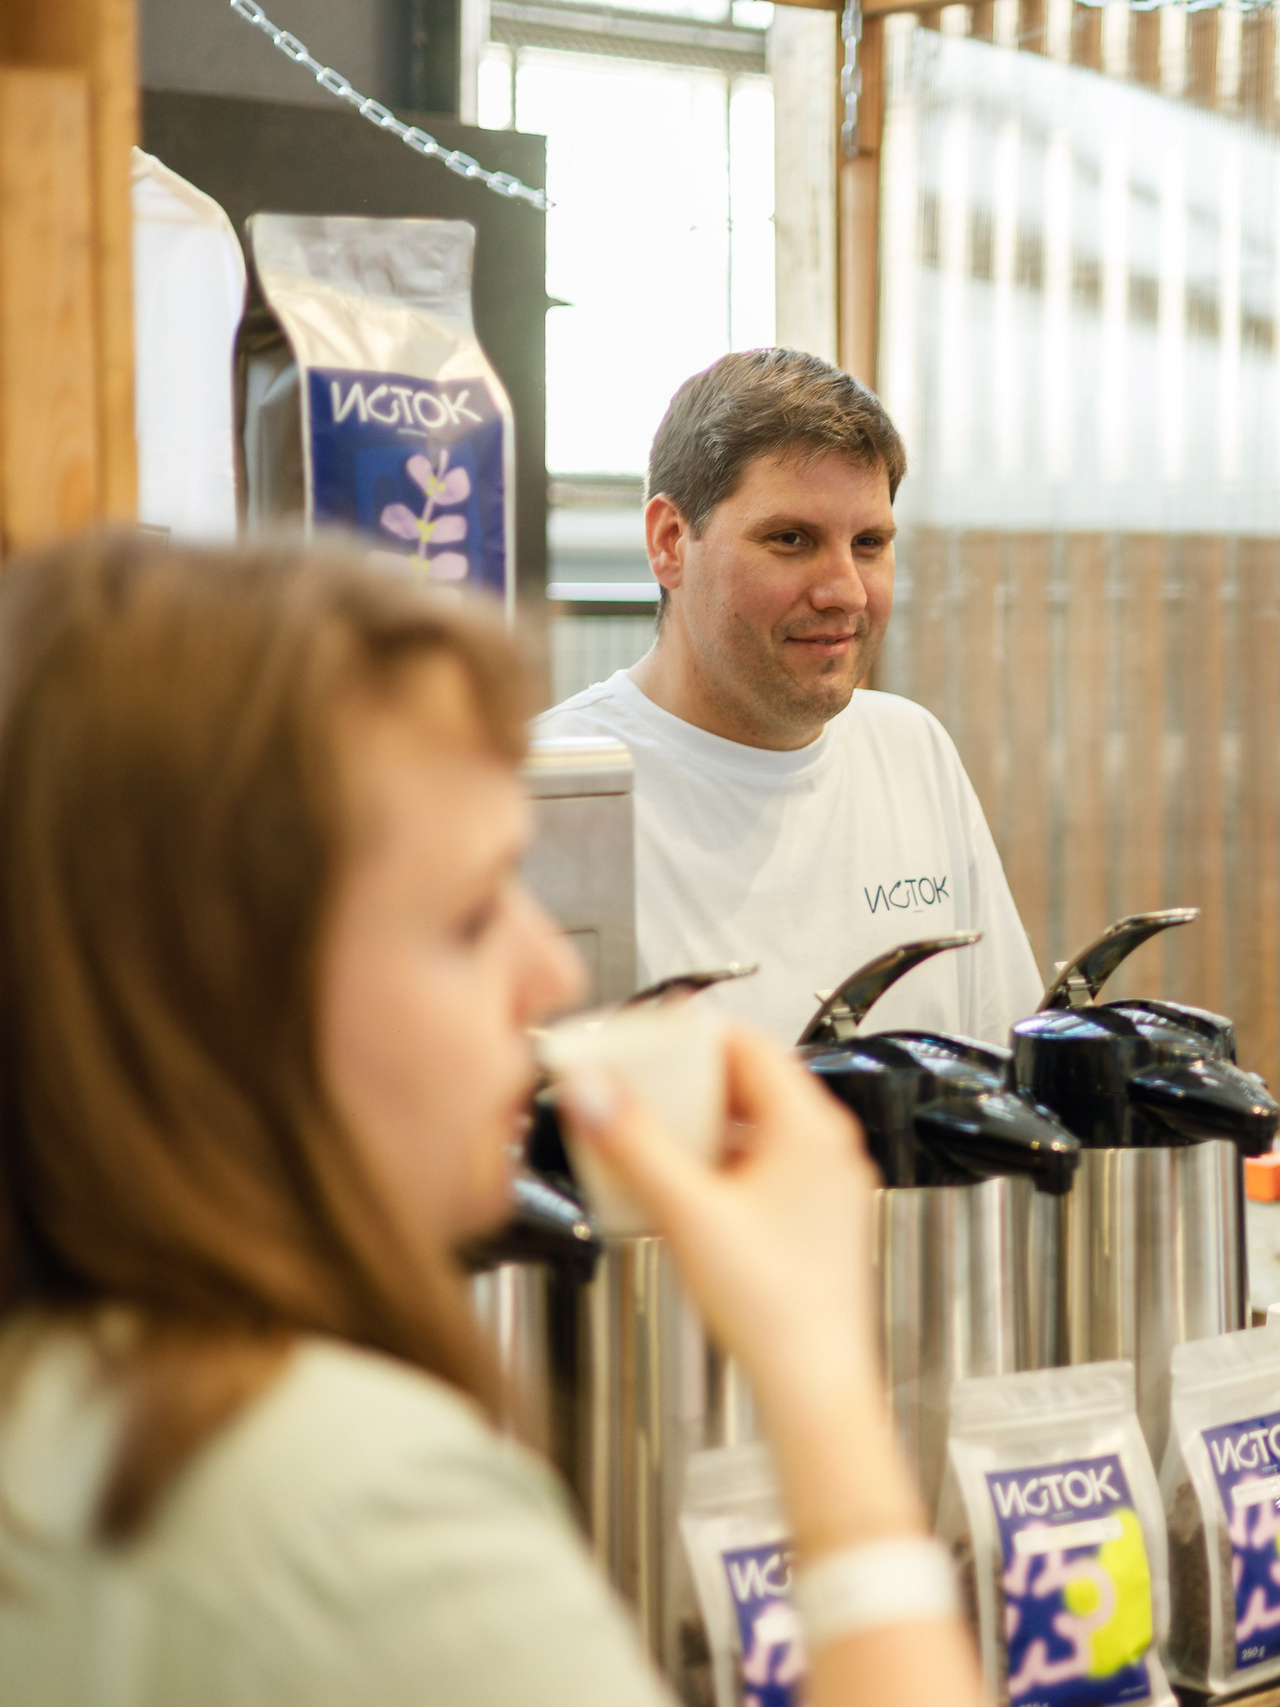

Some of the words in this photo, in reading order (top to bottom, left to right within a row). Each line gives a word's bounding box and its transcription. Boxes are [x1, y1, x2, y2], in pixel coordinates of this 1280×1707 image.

[331, 380, 483, 428] ИСТОК
[864, 875, 950, 914] ИСТОК
[992, 1464, 1120, 1519] ИСТОК
